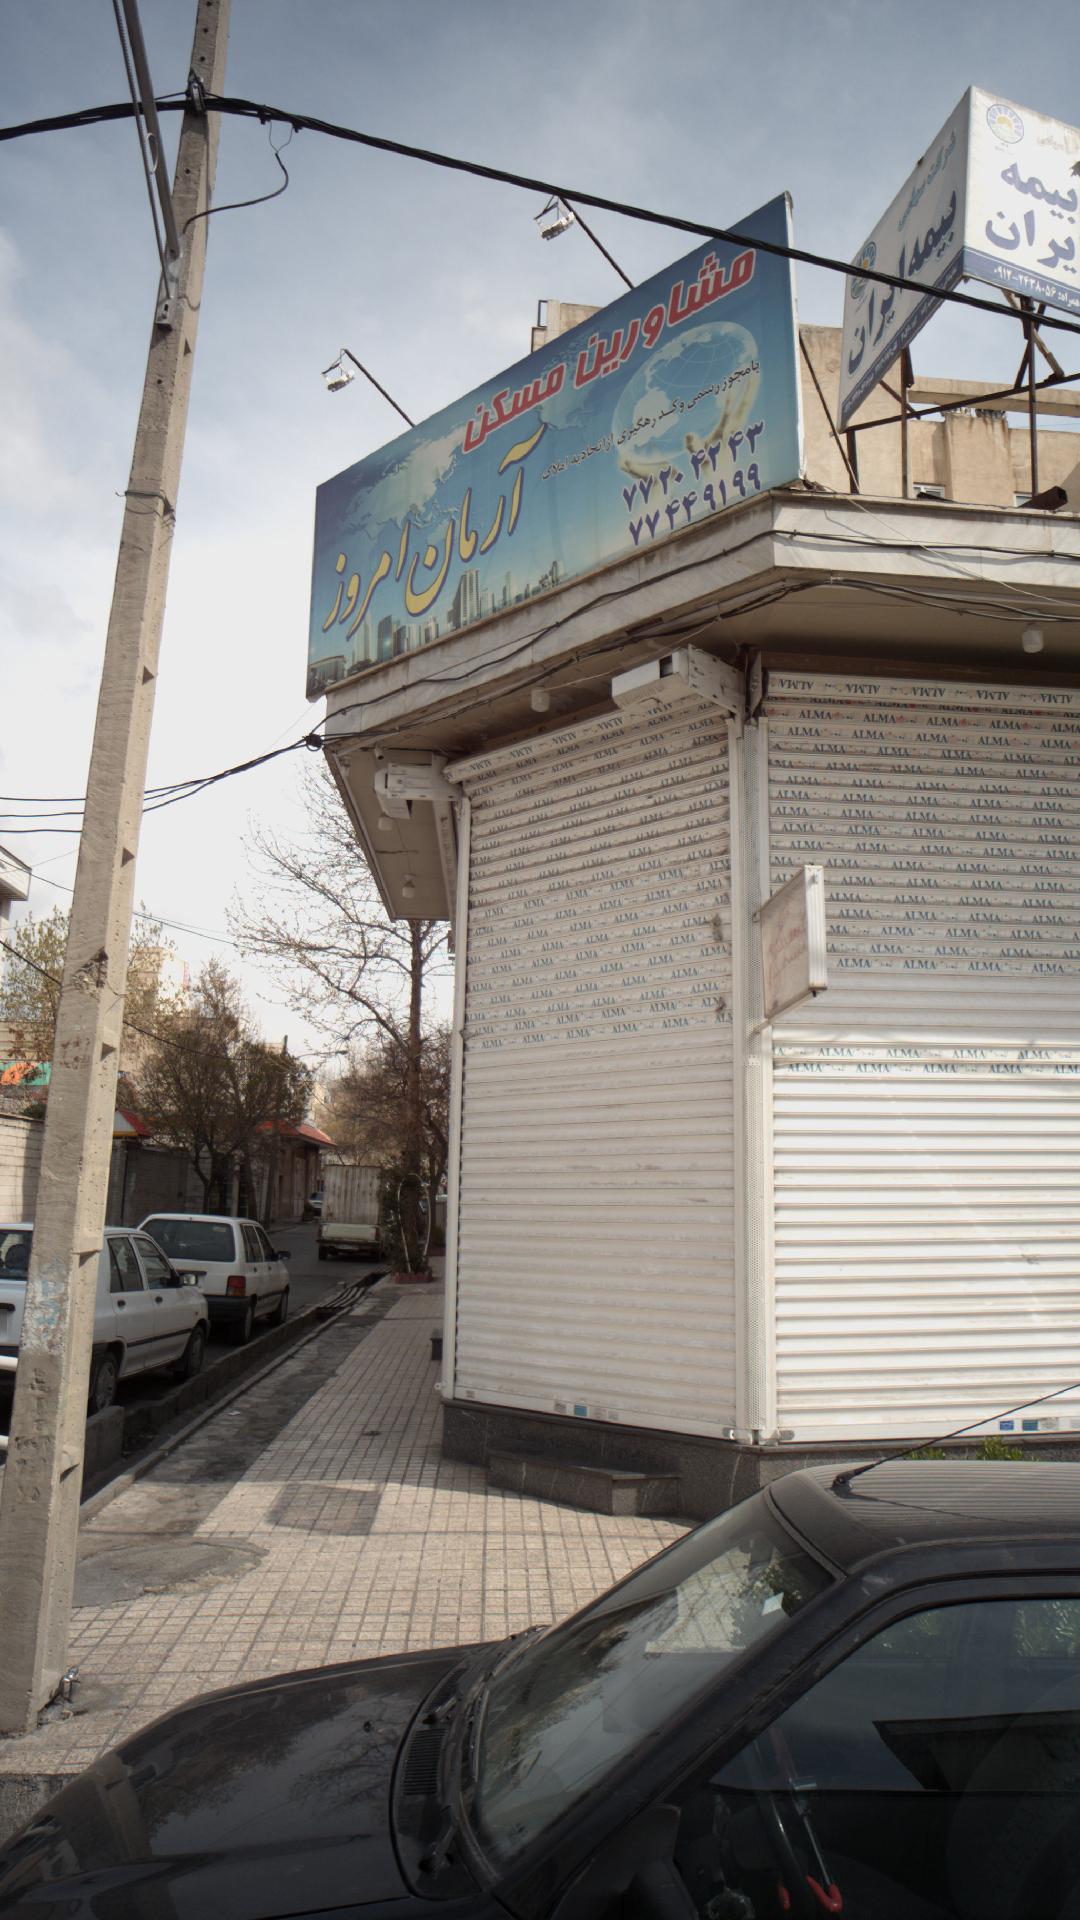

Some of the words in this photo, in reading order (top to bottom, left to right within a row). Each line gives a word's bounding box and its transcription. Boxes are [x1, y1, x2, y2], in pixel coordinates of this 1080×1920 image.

[1000, 162, 1078, 224] بیمه
[908, 190, 957, 278] بیمه
[985, 209, 1077, 274] یران
[573, 248, 757, 389] مشاورین
[462, 361, 567, 455] مسکن
[688, 385, 720, 409] رسمی
[617, 417, 656, 445] رهگیری
[405, 422, 547, 617] آرمان
[322, 519, 411, 641] امروز
[800, 710, 832, 720] ALMA
[864, 714, 896, 723] ALMA
[927, 717, 959, 727] ALMA
[990, 720, 1020, 729] ALMA
[788, 727, 820, 737] ALMA
[852, 730, 884, 740] ALMA
[916, 733, 948, 743] ALMA
[979, 737, 1009, 745] ALMA
[1041, 740, 1070, 749] ALMA
[813, 744, 845, 753] ALMA
[878, 747, 908, 756] ALMA
[1003, 754, 1033, 763] ALMA
[826, 761, 858, 771] ALMA
[955, 766, 984, 776] ALMA
[1017, 769, 1046, 778] ALMA
[787, 775, 819, 785] ALMA
[851, 778, 883, 788] ALMA
[979, 784, 1008, 793] ALMA
[1041, 787, 1070, 796] ALMA
[777, 790, 809, 800] ALMA
[842, 793, 874, 803] ALMA
[908, 796, 937, 805] ALMA
[971, 799, 1001, 808] ALMA
[1033, 801, 1063, 811] ALMA
[776, 806, 808, 816] ALMA
[840, 809, 873, 818] ALMA
[907, 812, 936, 821] ALMA
[970, 814, 1000, 824] ALMA
[1032, 817, 1062, 827] ALMA
[781, 823, 814, 832] ALMA
[848, 826, 880, 835] ALMA
[911, 828, 944, 837] ALMA
[976, 831, 1006, 840] ALMA
[1038, 834, 1068, 844] ALMA
[790, 840, 822, 850] ALMA
[855, 843, 887, 853] ALMA
[919, 846, 951, 855] ALMA
[984, 847, 1014, 857] ALMA
[1046, 850, 1076, 859] ALMA
[826, 858, 858, 868] ALMA
[892, 861, 924, 871] ALMA
[957, 863, 987, 872] ALMA
[1020, 865, 1050, 874] ALMA
[842, 876, 874, 886] ALMA
[907, 878, 939, 888] ALMA
[972, 880, 1001, 889] ALMA
[1034, 882, 1064, 891] ALMA
[507, 890, 528, 901] ALMA
[829, 892, 861, 902] ALMA
[894, 895, 926, 904] ALMA
[958, 896, 990, 906] ALMA
[1023, 899, 1052, 908] ALMA
[473, 926, 495, 937] ALMA
[513, 918, 534, 929] ALMA
[554, 909, 577, 921] ALMA
[598, 899, 623, 912] ALMA
[644, 889, 672, 902] ALMA
[839, 909, 871, 919] ALMA
[903, 911, 936, 920] ALMA
[970, 913, 999, 922] ALMA
[1031, 915, 1063, 925] ALMA
[486, 937, 508, 948] ALMA
[526, 928, 549, 941] ALMA
[570, 920, 591, 932] ALMA
[613, 912, 639, 925] ALMA
[661, 902, 688, 914] ALMA
[881, 926, 913, 935] ALMA
[945, 928, 978, 937] ALMA
[1011, 930, 1041, 939] ALMA
[498, 946, 522, 959] ALMA
[539, 939, 563, 952] ALMA
[584, 933, 610, 946] ALMA
[633, 924, 656, 937] ALMA
[683, 915, 708, 929] ALMA
[490, 963, 512, 974] ALMA
[530, 956, 554, 968] ALMA
[572, 948, 598, 961] ALMA
[620, 942, 645, 953] ALMA
[668, 934, 696, 946] ALMA
[869, 944, 902, 953] ALMA
[934, 946, 967, 955] ALMA
[1000, 948, 1030, 957] ALMA
[470, 981, 492, 992] ALMA
[509, 974, 533, 987] ALMA
[554, 970, 577, 982] ALMA
[598, 962, 623, 973] ALMA
[646, 954, 674, 966] ALMA
[698, 945, 727, 957] ALMA
[837, 958, 870, 967] ALMA
[904, 960, 936, 969] ALMA
[968, 962, 1000, 971] ALMA
[1032, 963, 1064, 973] ALMA
[488, 993, 510, 1005] ALMA
[530, 989, 554, 1001] ALMA
[576, 981, 597, 994] ALMA
[621, 975, 646, 986] ALMA
[670, 967, 698, 979] ALMA
[502, 1006, 526, 1018] ALMA
[591, 996, 616, 1007] ALMA
[638, 989, 666, 1001] ALMA
[689, 981, 719, 994] ALMA
[473, 1026, 495, 1037] ALMA
[514, 1020, 535, 1031] ALMA
[556, 1014, 579, 1026] ALMA
[600, 1007, 625, 1018] ALMA
[648, 1001, 676, 1013] ALMA
[480, 1037, 502, 1049] ALMA
[520, 1032, 544, 1044] ALMA
[565, 1028, 590, 1039] ALMA
[612, 1022, 637, 1034] ALMA
[661, 1017, 688, 1029] ALMA
[818, 1048, 853, 1057] ALMA
[887, 1049, 921, 1058] ALMA
[952, 1050, 986, 1059] ALMA
[1018, 1051, 1051, 1060] ALMA
[788, 1064, 823, 1073] ALMA
[856, 1064, 889, 1073] ALMA
[923, 1065, 957, 1073] ALMA
[990, 1065, 1023, 1074] ALMA
